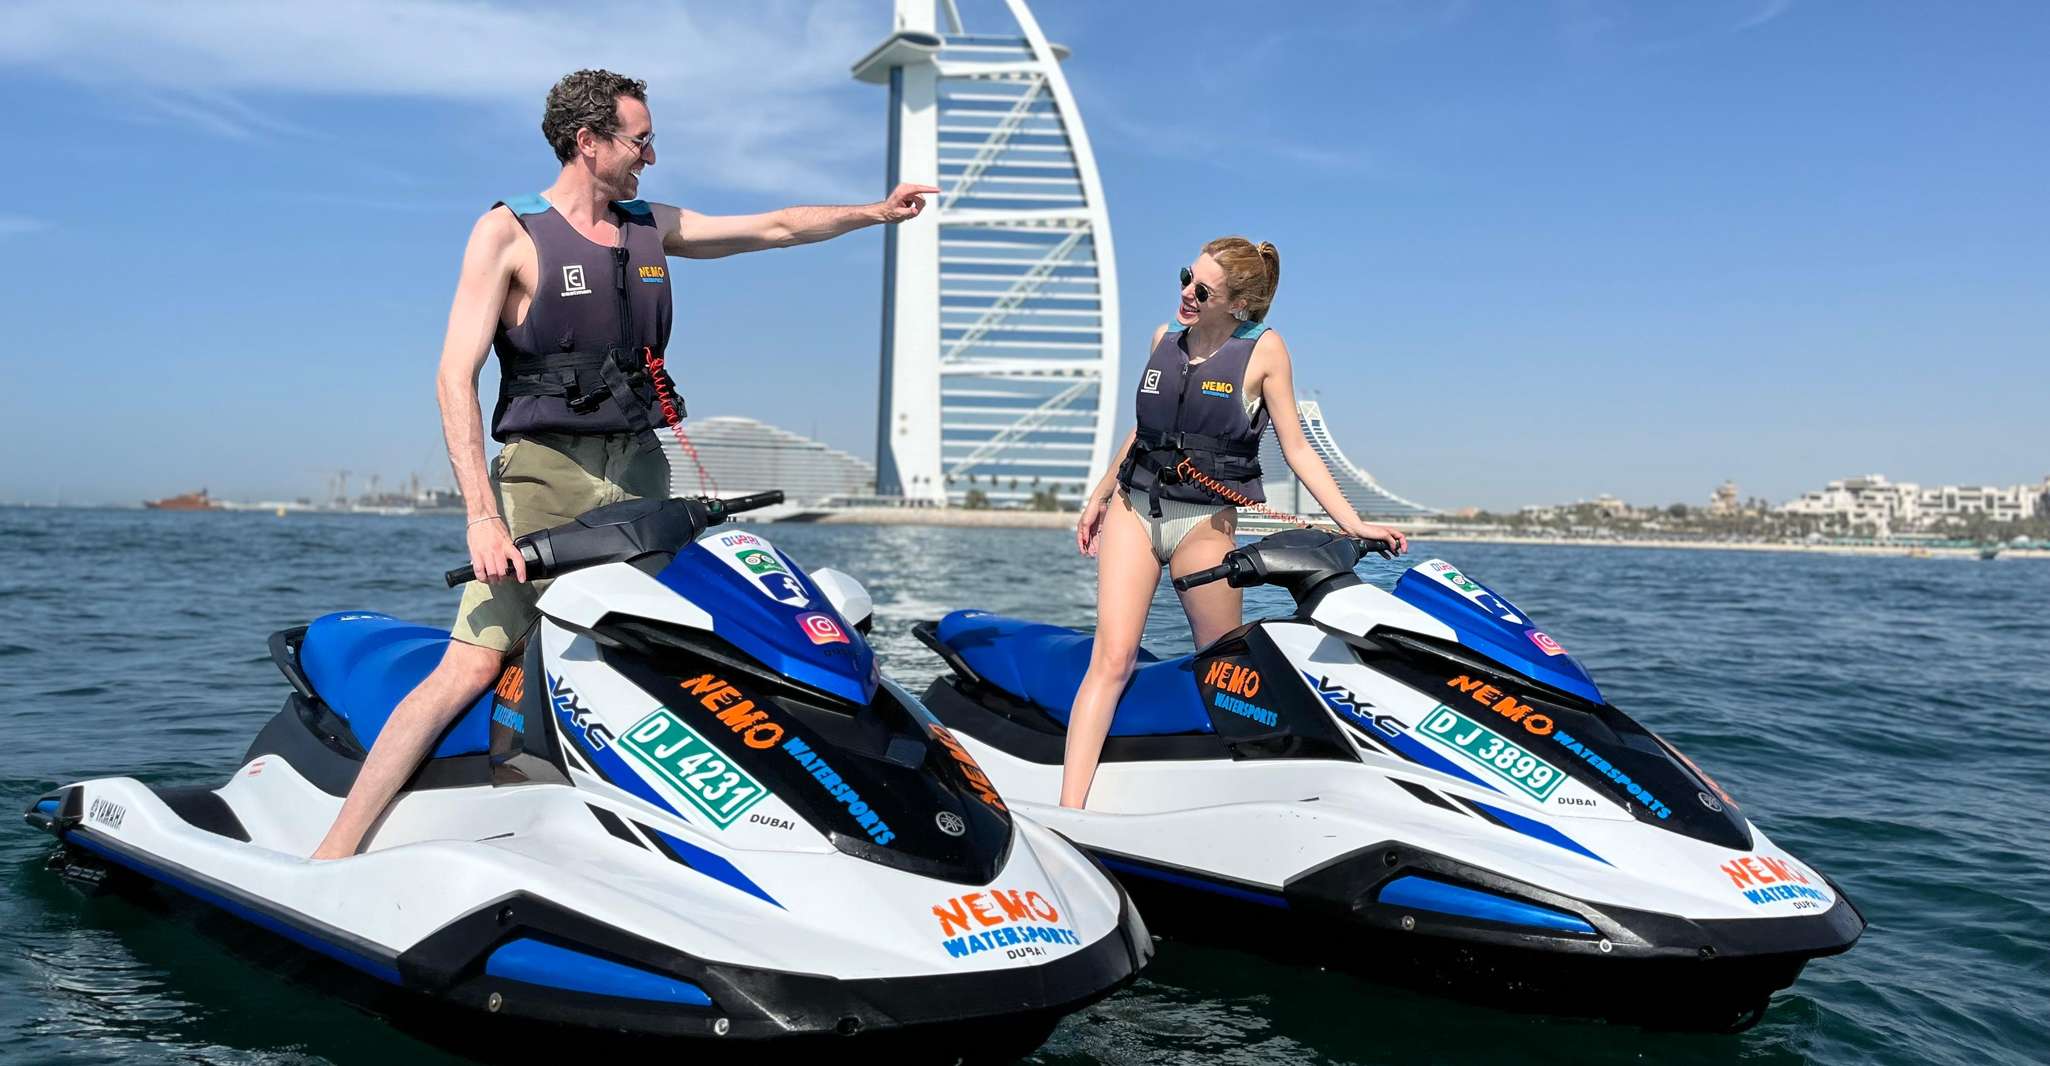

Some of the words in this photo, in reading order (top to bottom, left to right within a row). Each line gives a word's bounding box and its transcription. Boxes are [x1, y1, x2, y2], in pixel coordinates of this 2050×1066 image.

[638, 266, 664, 278] NEMO
[1201, 381, 1233, 394] NEMO
[1204, 661, 1262, 698] NEMO
[1214, 692, 1278, 727] WATERSPORTS
[680, 673, 785, 750] NEMO
[782, 736, 896, 846] WATERSPORTS
[1447, 675, 1555, 736] NEMO
[1552, 730, 1672, 819] WATERSPORTS
[1478, 738, 1554, 790] 3899
[676, 751, 756, 815] 4231
[1557, 797, 1597, 807] DUBAI
[750, 814, 796, 831] DUBAI
[1719, 855, 1810, 889] NEMO
[931, 889, 1059, 938] NEMO
[943, 926, 1081, 959] WATERSPORTS
